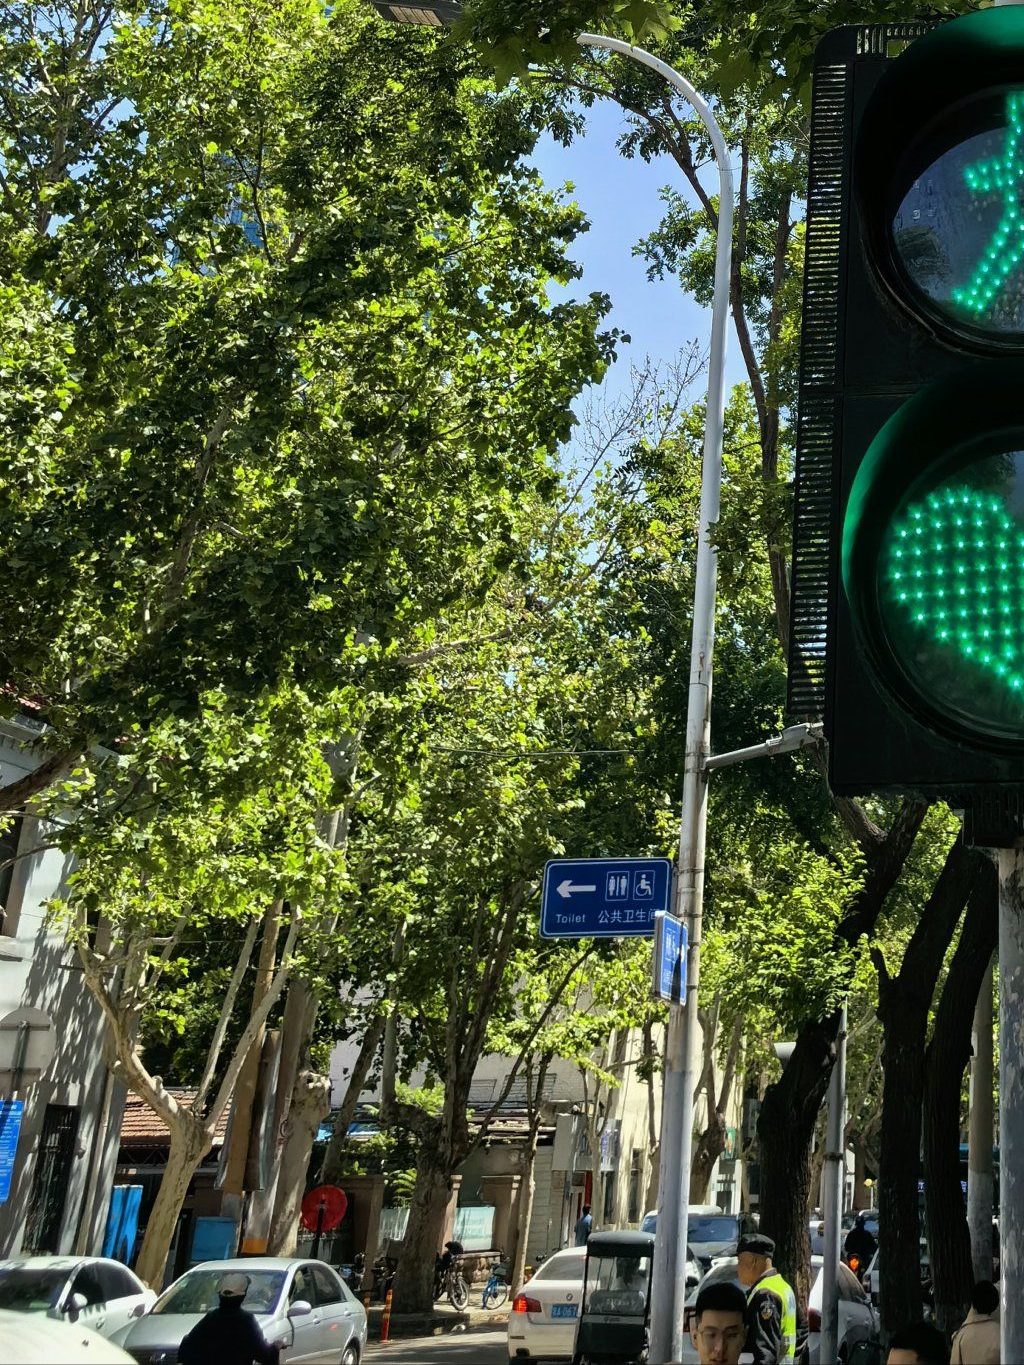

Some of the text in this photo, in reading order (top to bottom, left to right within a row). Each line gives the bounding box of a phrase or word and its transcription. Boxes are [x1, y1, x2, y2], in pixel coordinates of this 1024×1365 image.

[556, 913, 586, 924] Toilet
[597, 909, 660, 924] 公共卫生间
